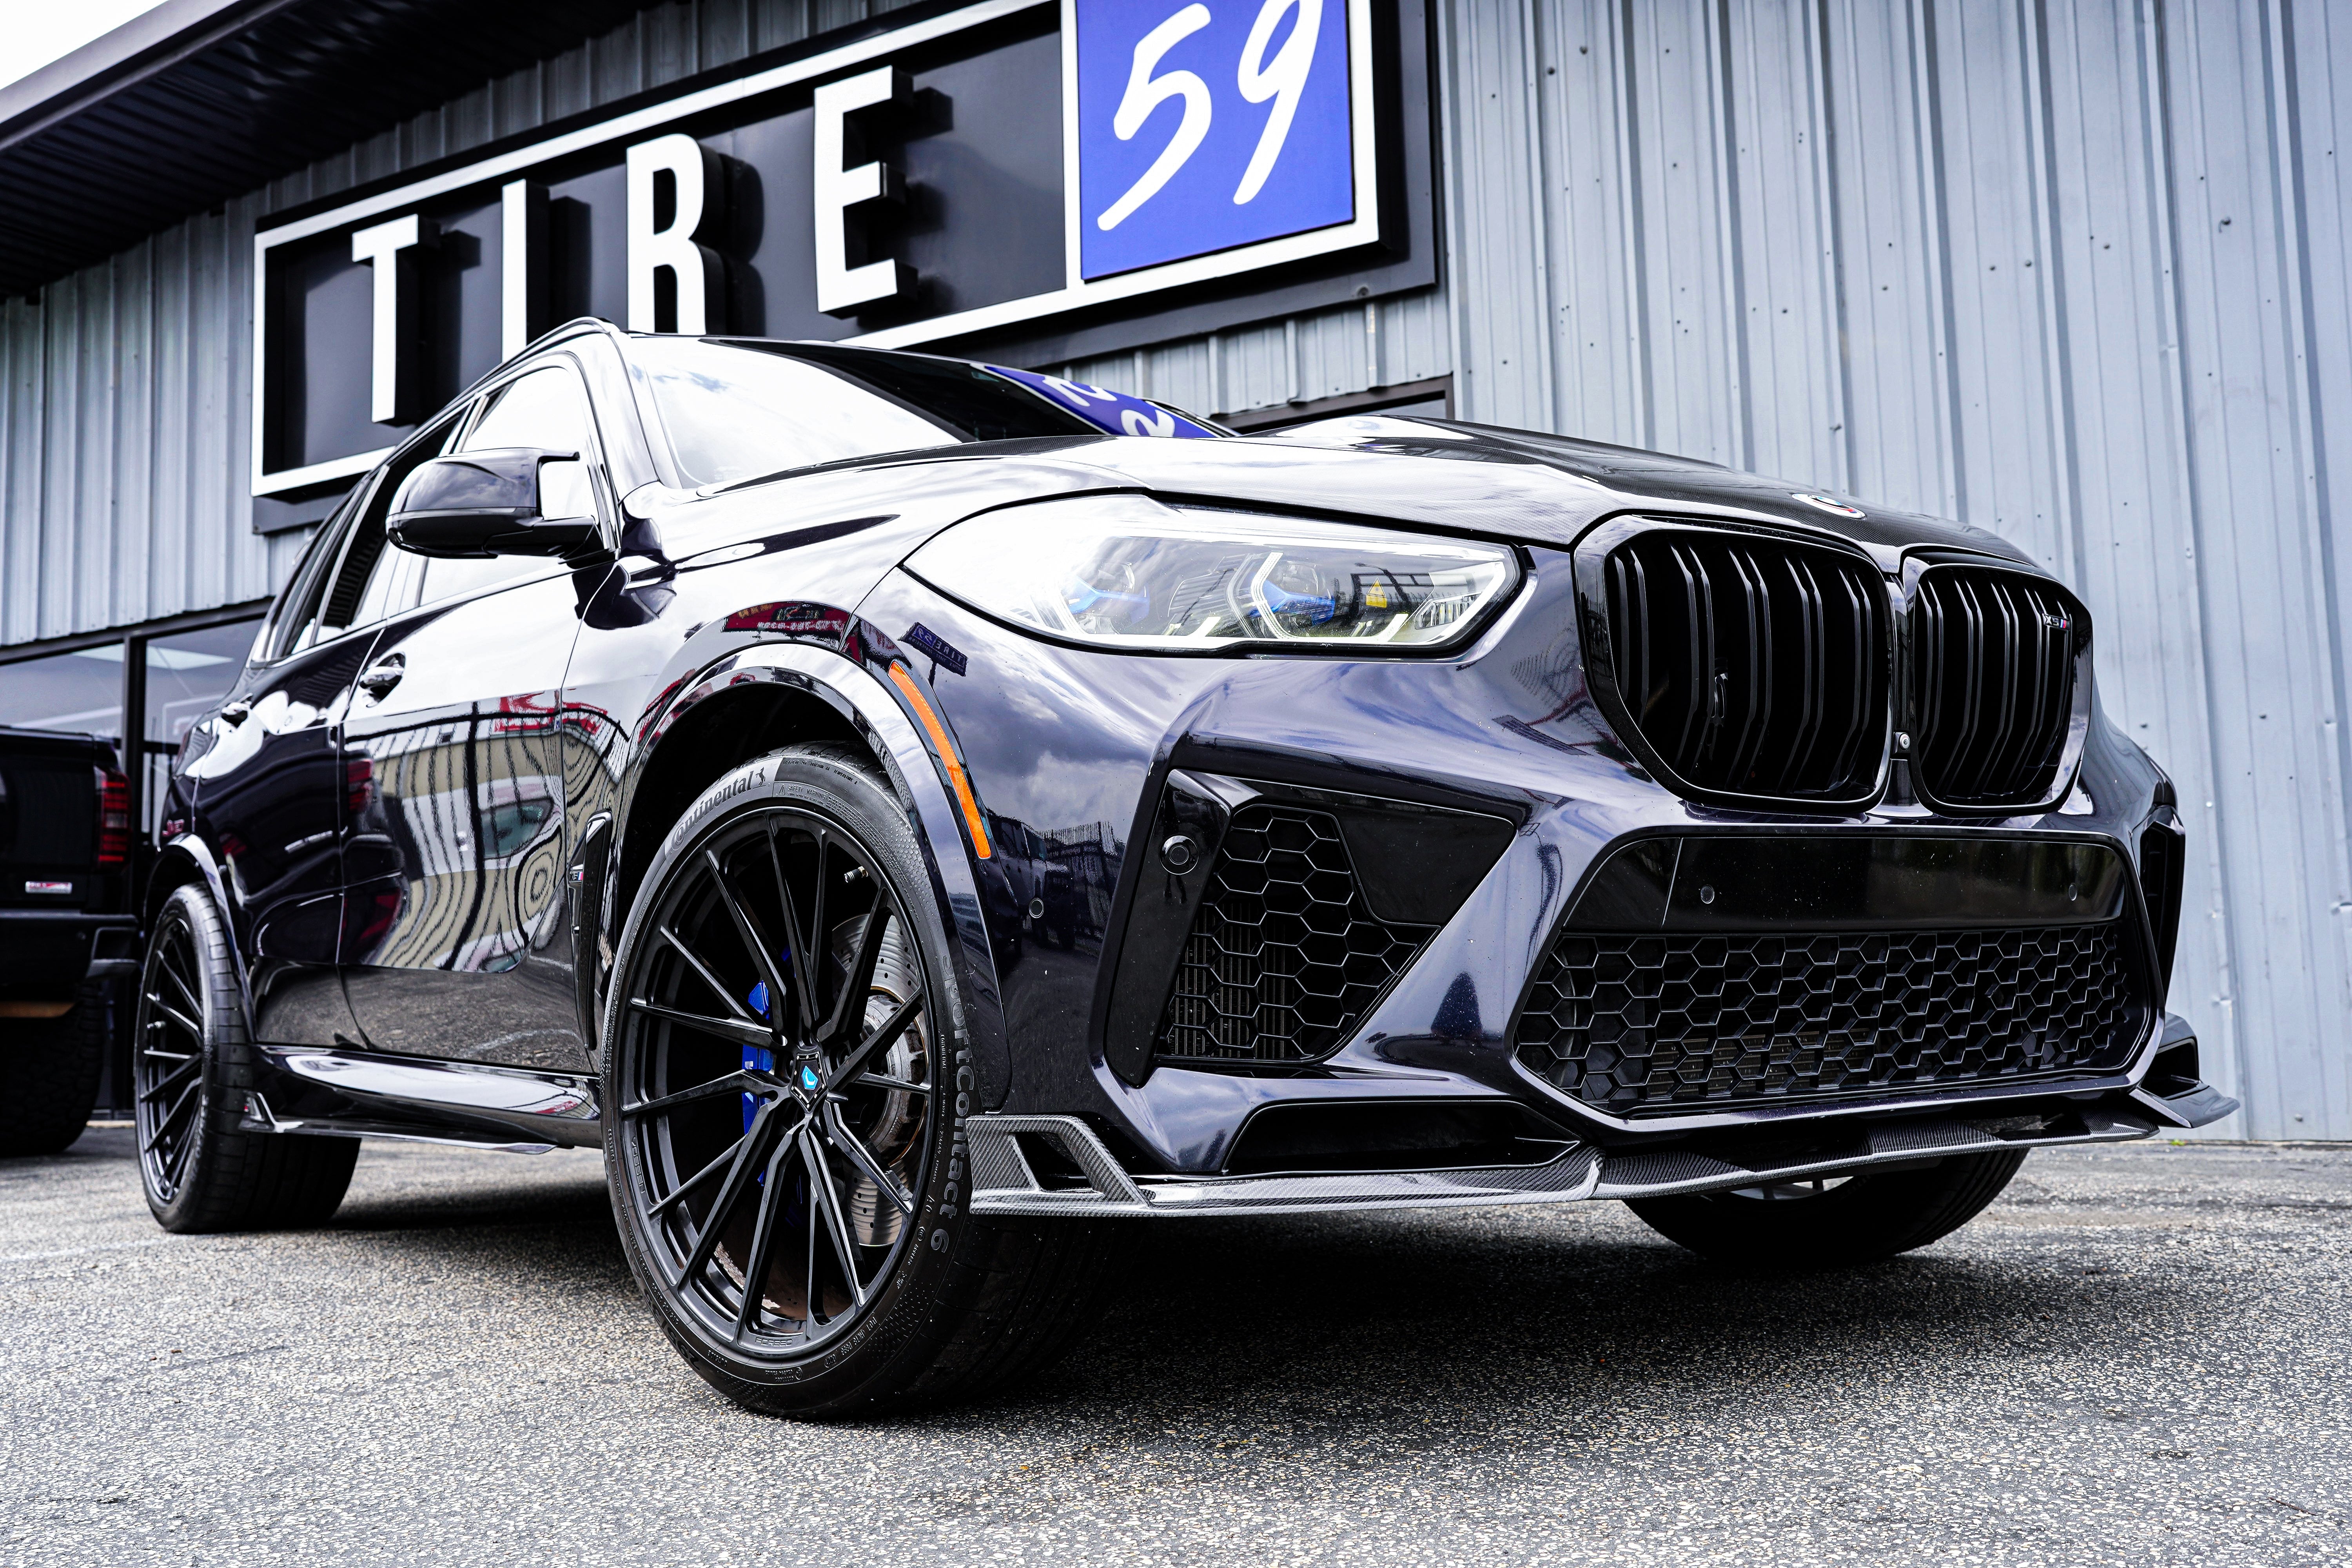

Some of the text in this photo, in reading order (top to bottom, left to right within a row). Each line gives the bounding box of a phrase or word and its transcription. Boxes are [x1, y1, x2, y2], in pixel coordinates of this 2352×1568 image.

[352, 0, 1323, 423] TIRE 59
[806, 788, 826, 800] WARNING
[671, 770, 755, 851] Continental
[931, 1229, 949, 1253] 6
[754, 1337, 793, 1347] FORGED
